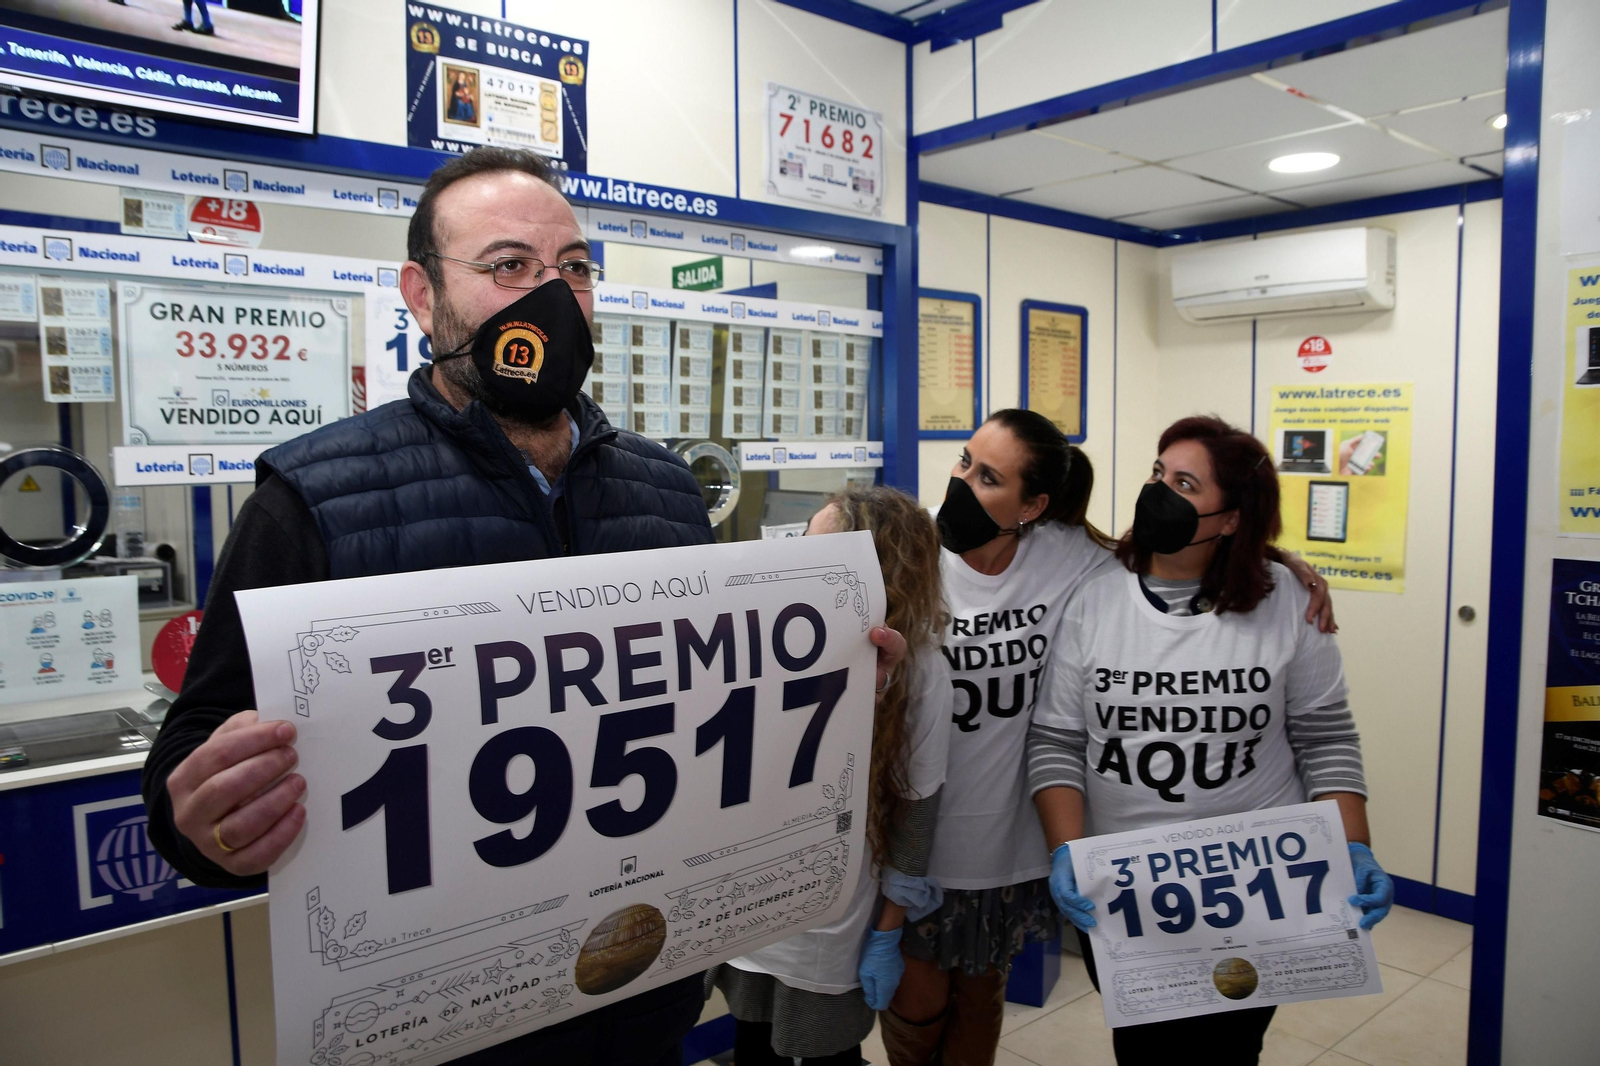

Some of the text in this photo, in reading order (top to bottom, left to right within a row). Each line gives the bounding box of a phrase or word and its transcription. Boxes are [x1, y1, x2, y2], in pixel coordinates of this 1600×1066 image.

[408, 4, 583, 55] www.latrece.es
[455, 35, 544, 67] SE BUSCA
[7, 41, 71, 68] Tenerife,
[72, 54, 134, 79] Valencia,
[176, 74, 231, 96] Granada,
[232, 84, 282, 103] Alicante.
[486, 77, 535, 96] 47017
[809, 99, 866, 129] PREMIO
[779, 112, 874, 160] 71682
[76, 156, 140, 175] Nacional
[171, 169, 305, 196] Lotería Nacional
[333, 189, 374, 203] Lotería
[597, 222, 684, 239] Lotería Nacional
[78, 246, 140, 263] Nacional
[701, 235, 778, 252] Lotería Nacional
[172, 255, 305, 277] Lotería Nacional
[333, 270, 373, 283] Lotería
[677, 264, 717, 288] SALIDA
[599, 294, 685, 310] Lotería Nacional
[702, 305, 778, 319] Lotería Nacional
[149, 302, 326, 328] GRAN PREMIO
[792, 313, 859, 327] Lotería Nacional
[176, 330, 308, 361] 33.932 €
[509, 343, 530, 365] 13
[231, 398, 307, 407] EUROMILLONES
[1278, 387, 1402, 399] www.latrece.es
[160, 405, 322, 425] VENDIDO AQUÍ
[136, 461, 184, 473] Lotería
[745, 451, 817, 461] Lotería Nacional
[830, 451, 853, 460] Lotería
[516, 570, 711, 614] VENDIDO AQUÍ
[370, 602, 828, 741] 3er PREMIO
[1095, 666, 1271, 695] 3er PREMIO
[1095, 701, 1271, 734] VENDIDO
[1095, 732, 1262, 803] AQUÍ
[340, 666, 849, 896] 19517
[1162, 820, 1244, 844] VENDIDO AQUÍ
[1111, 831, 1307, 888] 3er PREMIO
[589, 869, 665, 898] LOTERÍA NACIONAL
[697, 878, 822, 930] 22 DE DICIEMBRE 2021
[1107, 859, 1330, 938] 19517
[384, 926, 432, 946] La Trece
[1294, 965, 1332, 975] DICIEMBRE
[1128, 986, 1154, 995] LOTERÍA
[1168, 979, 1199, 989] NAVIDAD
[355, 976, 541, 1048] LOTERÍA DE NAVIDAD
